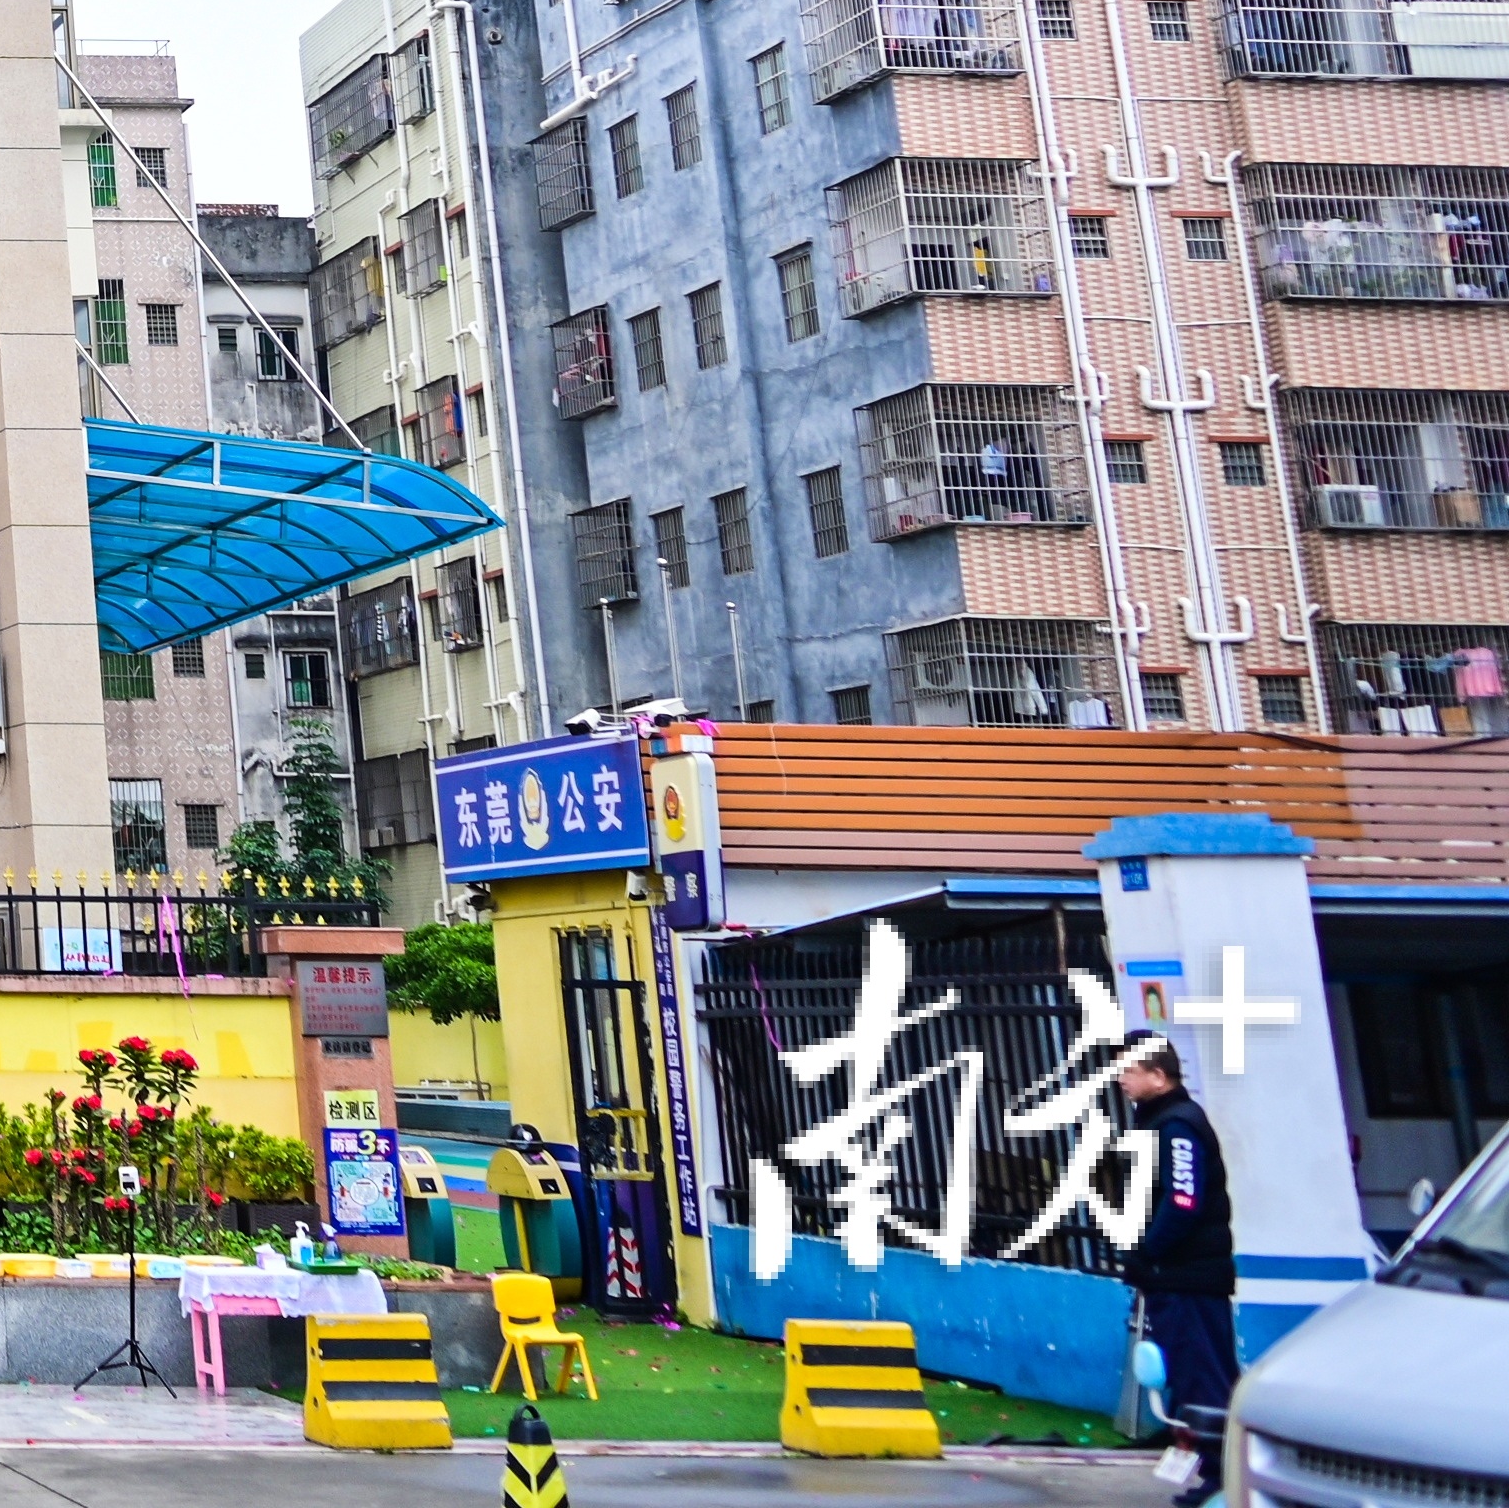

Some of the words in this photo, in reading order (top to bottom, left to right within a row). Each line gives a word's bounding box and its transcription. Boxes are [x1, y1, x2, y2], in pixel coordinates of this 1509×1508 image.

[454, 780, 513, 848] 东莞
[557, 764, 623, 833] 公安
[313, 966, 371, 984] 温馨提示
[329, 1099, 377, 1121] 检测区
[1171, 1137, 1195, 1196] COAST
